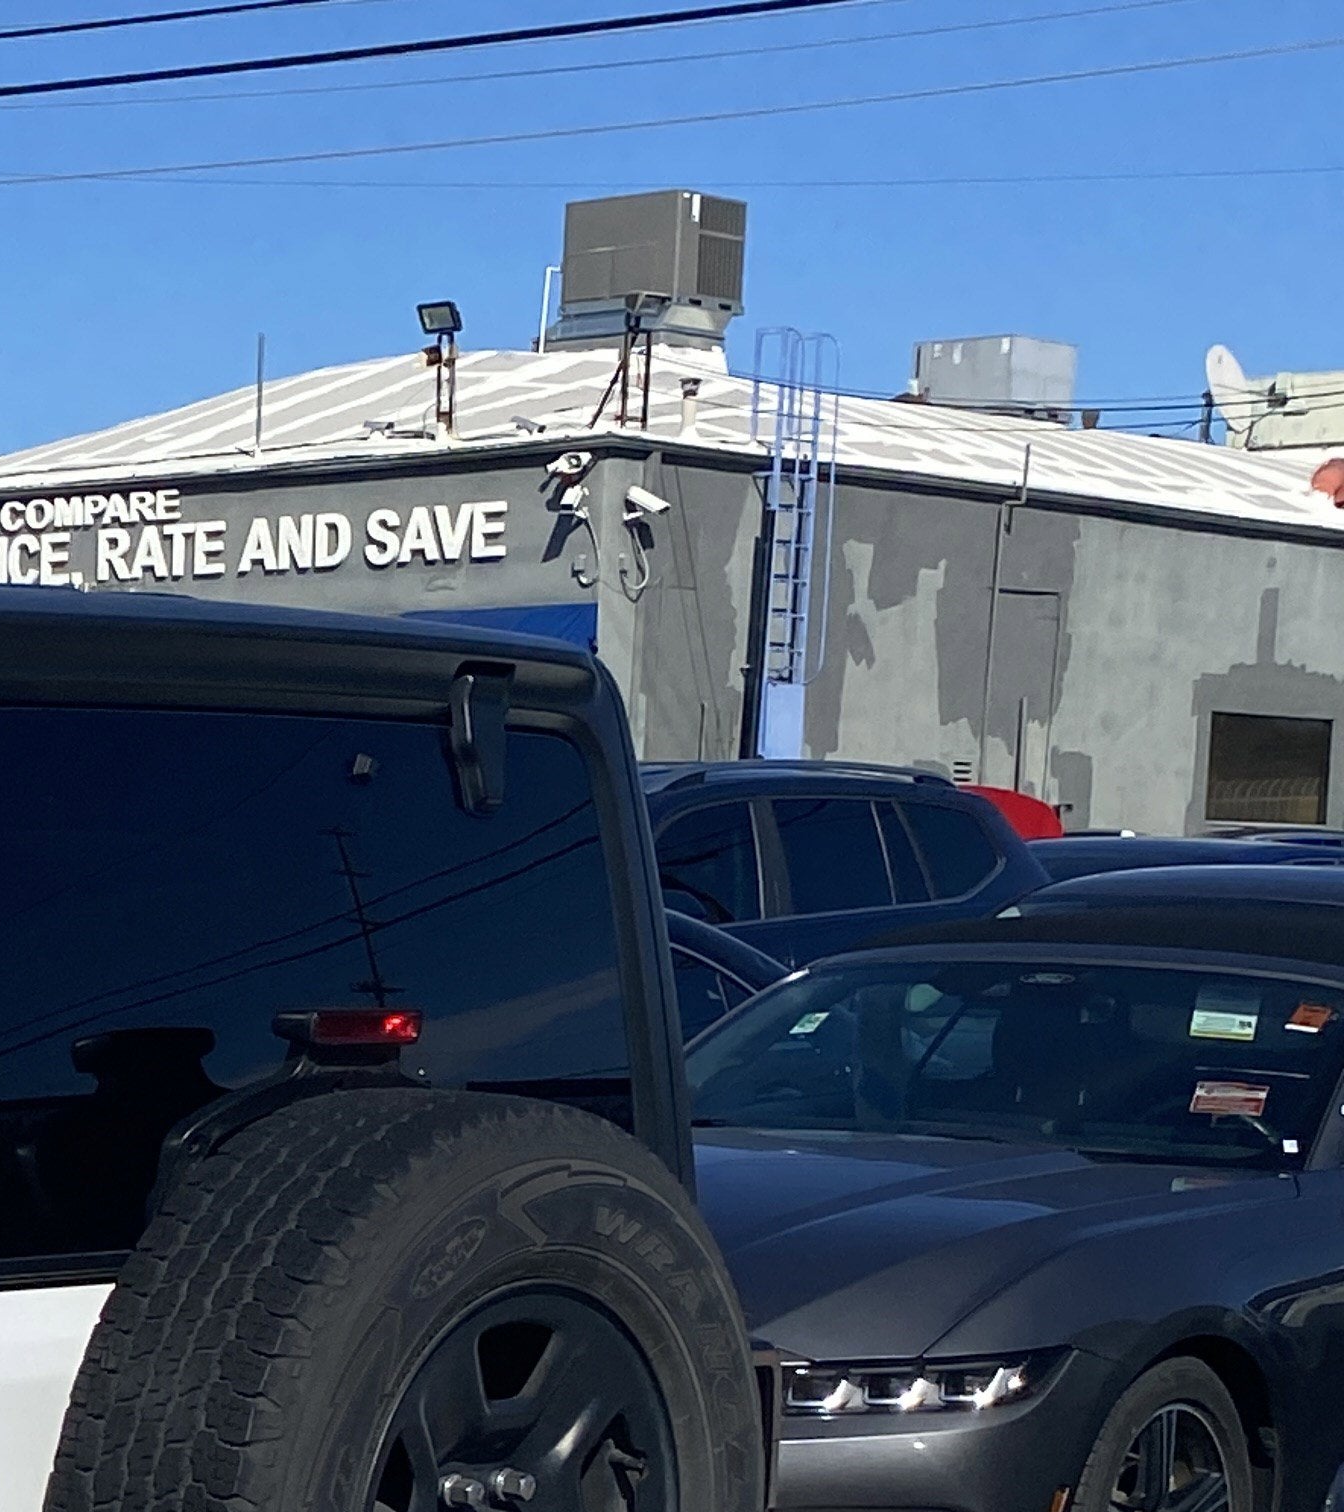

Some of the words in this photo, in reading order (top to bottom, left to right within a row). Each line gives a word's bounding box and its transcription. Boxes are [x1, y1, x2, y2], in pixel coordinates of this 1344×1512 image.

[0, 489, 181, 532] COMPARE
[96, 520, 226, 582] RATE
[237, 512, 352, 576] AND
[364, 501, 508, 569] SAVE
